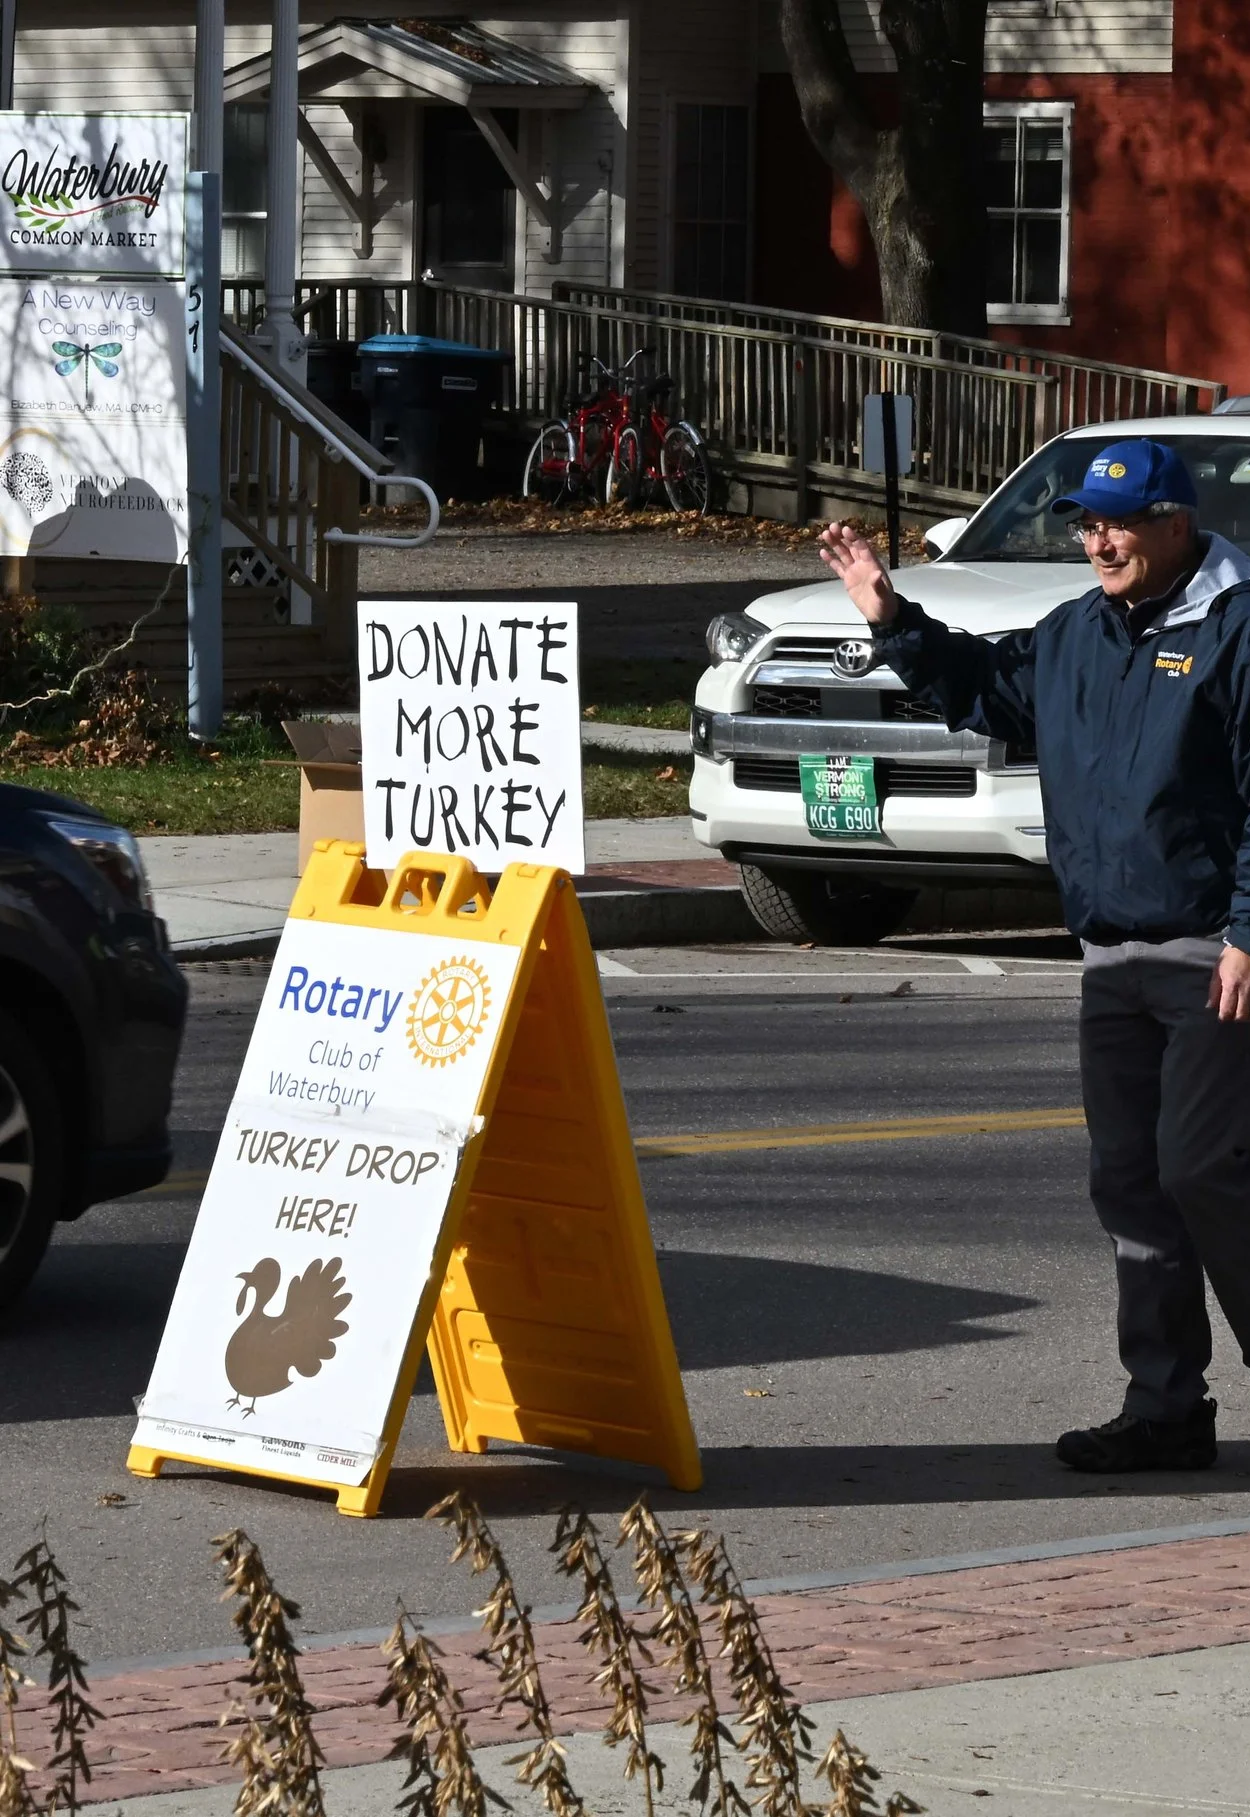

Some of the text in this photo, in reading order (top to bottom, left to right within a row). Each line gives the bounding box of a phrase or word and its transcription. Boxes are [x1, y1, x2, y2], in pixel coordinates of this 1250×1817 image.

[2, 143, 168, 218] Waterbury
[10, 230, 157, 247] COMMON MARKET
[21, 289, 156, 316] A New Way
[38, 318, 138, 341] Counseling
[60, 474, 130, 491] VERMONT
[60, 492, 184, 512] NEUROFEEDBACK
[366, 614, 568, 692] DONATE
[1155, 658, 1182, 670] Rotary
[396, 696, 541, 774] MORE
[813, 770, 864, 784] VERMONT
[815, 783, 866, 797] STRONG
[375, 778, 566, 853] TURKEY
[810, 805, 872, 830] KCG 690
[279, 965, 403, 1033] Rotary
[309, 1040, 384, 1072] Club of
[269, 1070, 376, 1113] Waterbury
[236, 1129, 439, 1185] TURKEY DROP
[275, 1196, 358, 1238] HERE!
[316, 1453, 357, 1468] CIDER MILL
